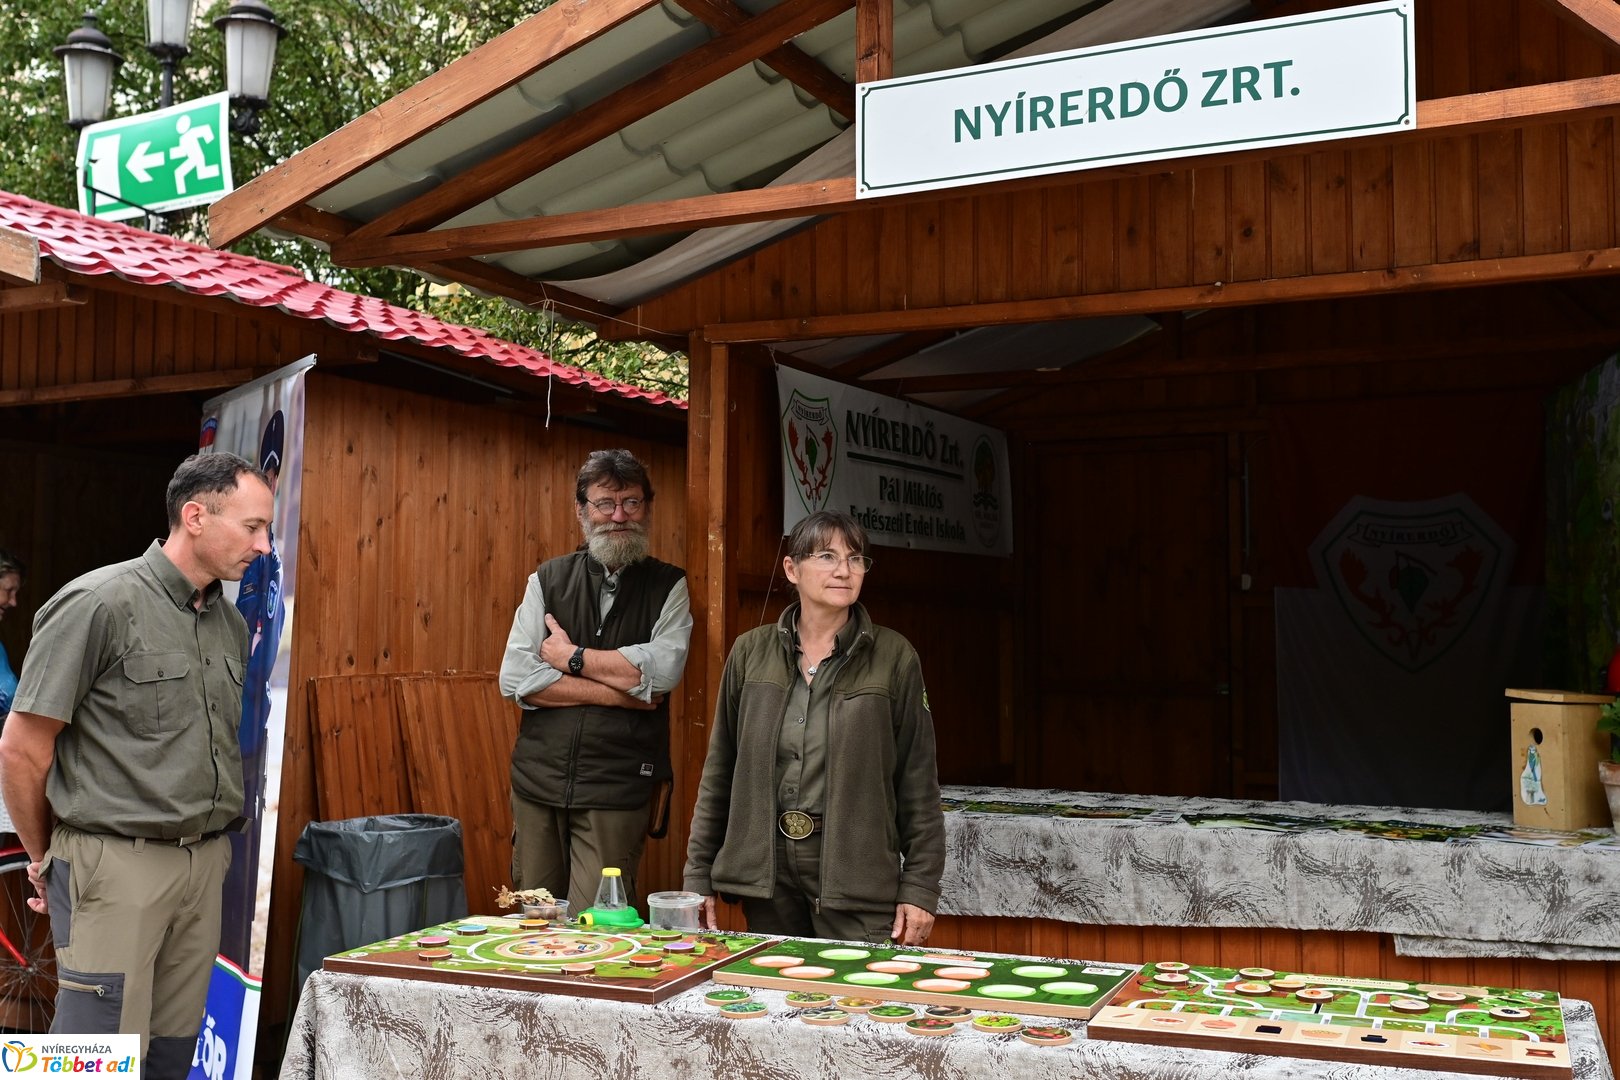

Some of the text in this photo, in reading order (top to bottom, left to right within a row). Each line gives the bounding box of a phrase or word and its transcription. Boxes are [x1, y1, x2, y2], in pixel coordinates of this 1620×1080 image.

[954, 59, 1301, 143] NYÍRERDŐ ZRT.
[846, 407, 964, 466] NYÍRERDŐ Zrt.
[879, 476, 944, 510] Pál Miklós
[905, 513, 933, 537] Erdei
[936, 517, 966, 540] Iskola
